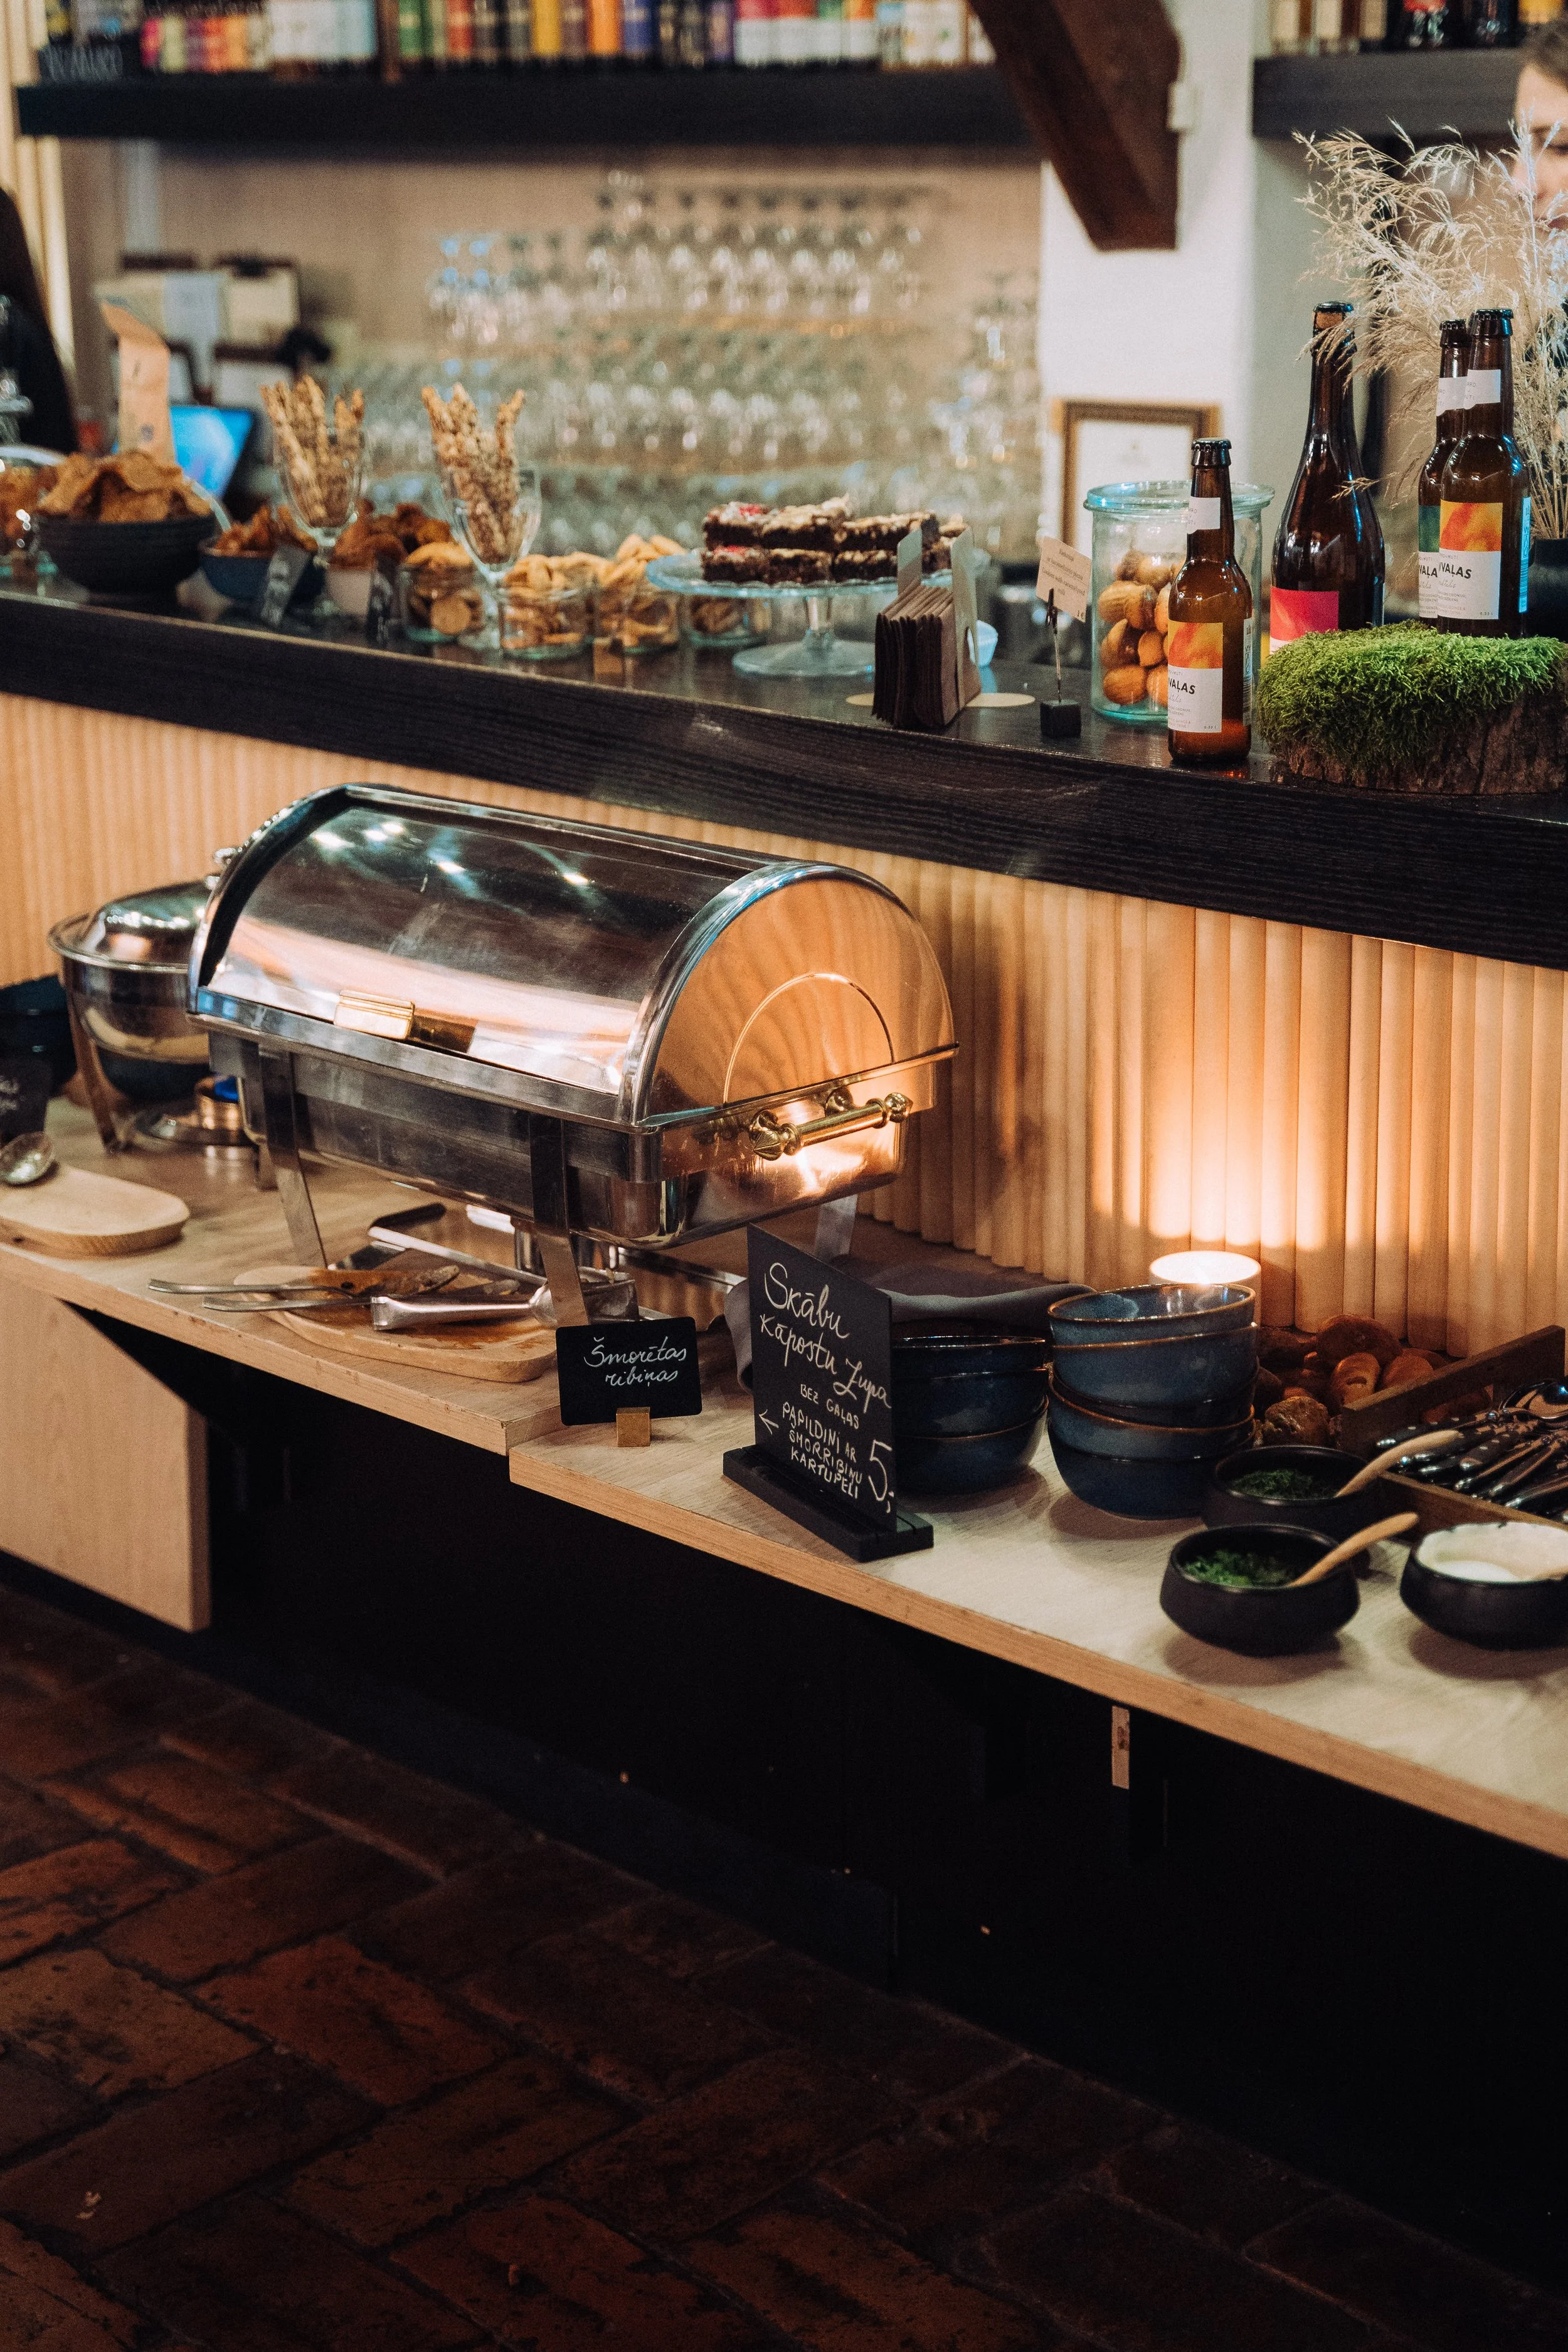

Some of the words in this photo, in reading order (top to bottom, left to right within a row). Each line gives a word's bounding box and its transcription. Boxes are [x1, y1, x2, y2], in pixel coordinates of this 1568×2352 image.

[764, 1262, 850, 1339] Skābu
[583, 1336, 687, 1367] Šmorētas
[760, 1313, 837, 1375] Kāpostu
[605, 1365, 679, 1387] ribiņas
[800, 1384, 819, 1405] BEZ
[826, 1398, 859, 1429] GAĻAS
[845, 1442, 857, 1463] AR
